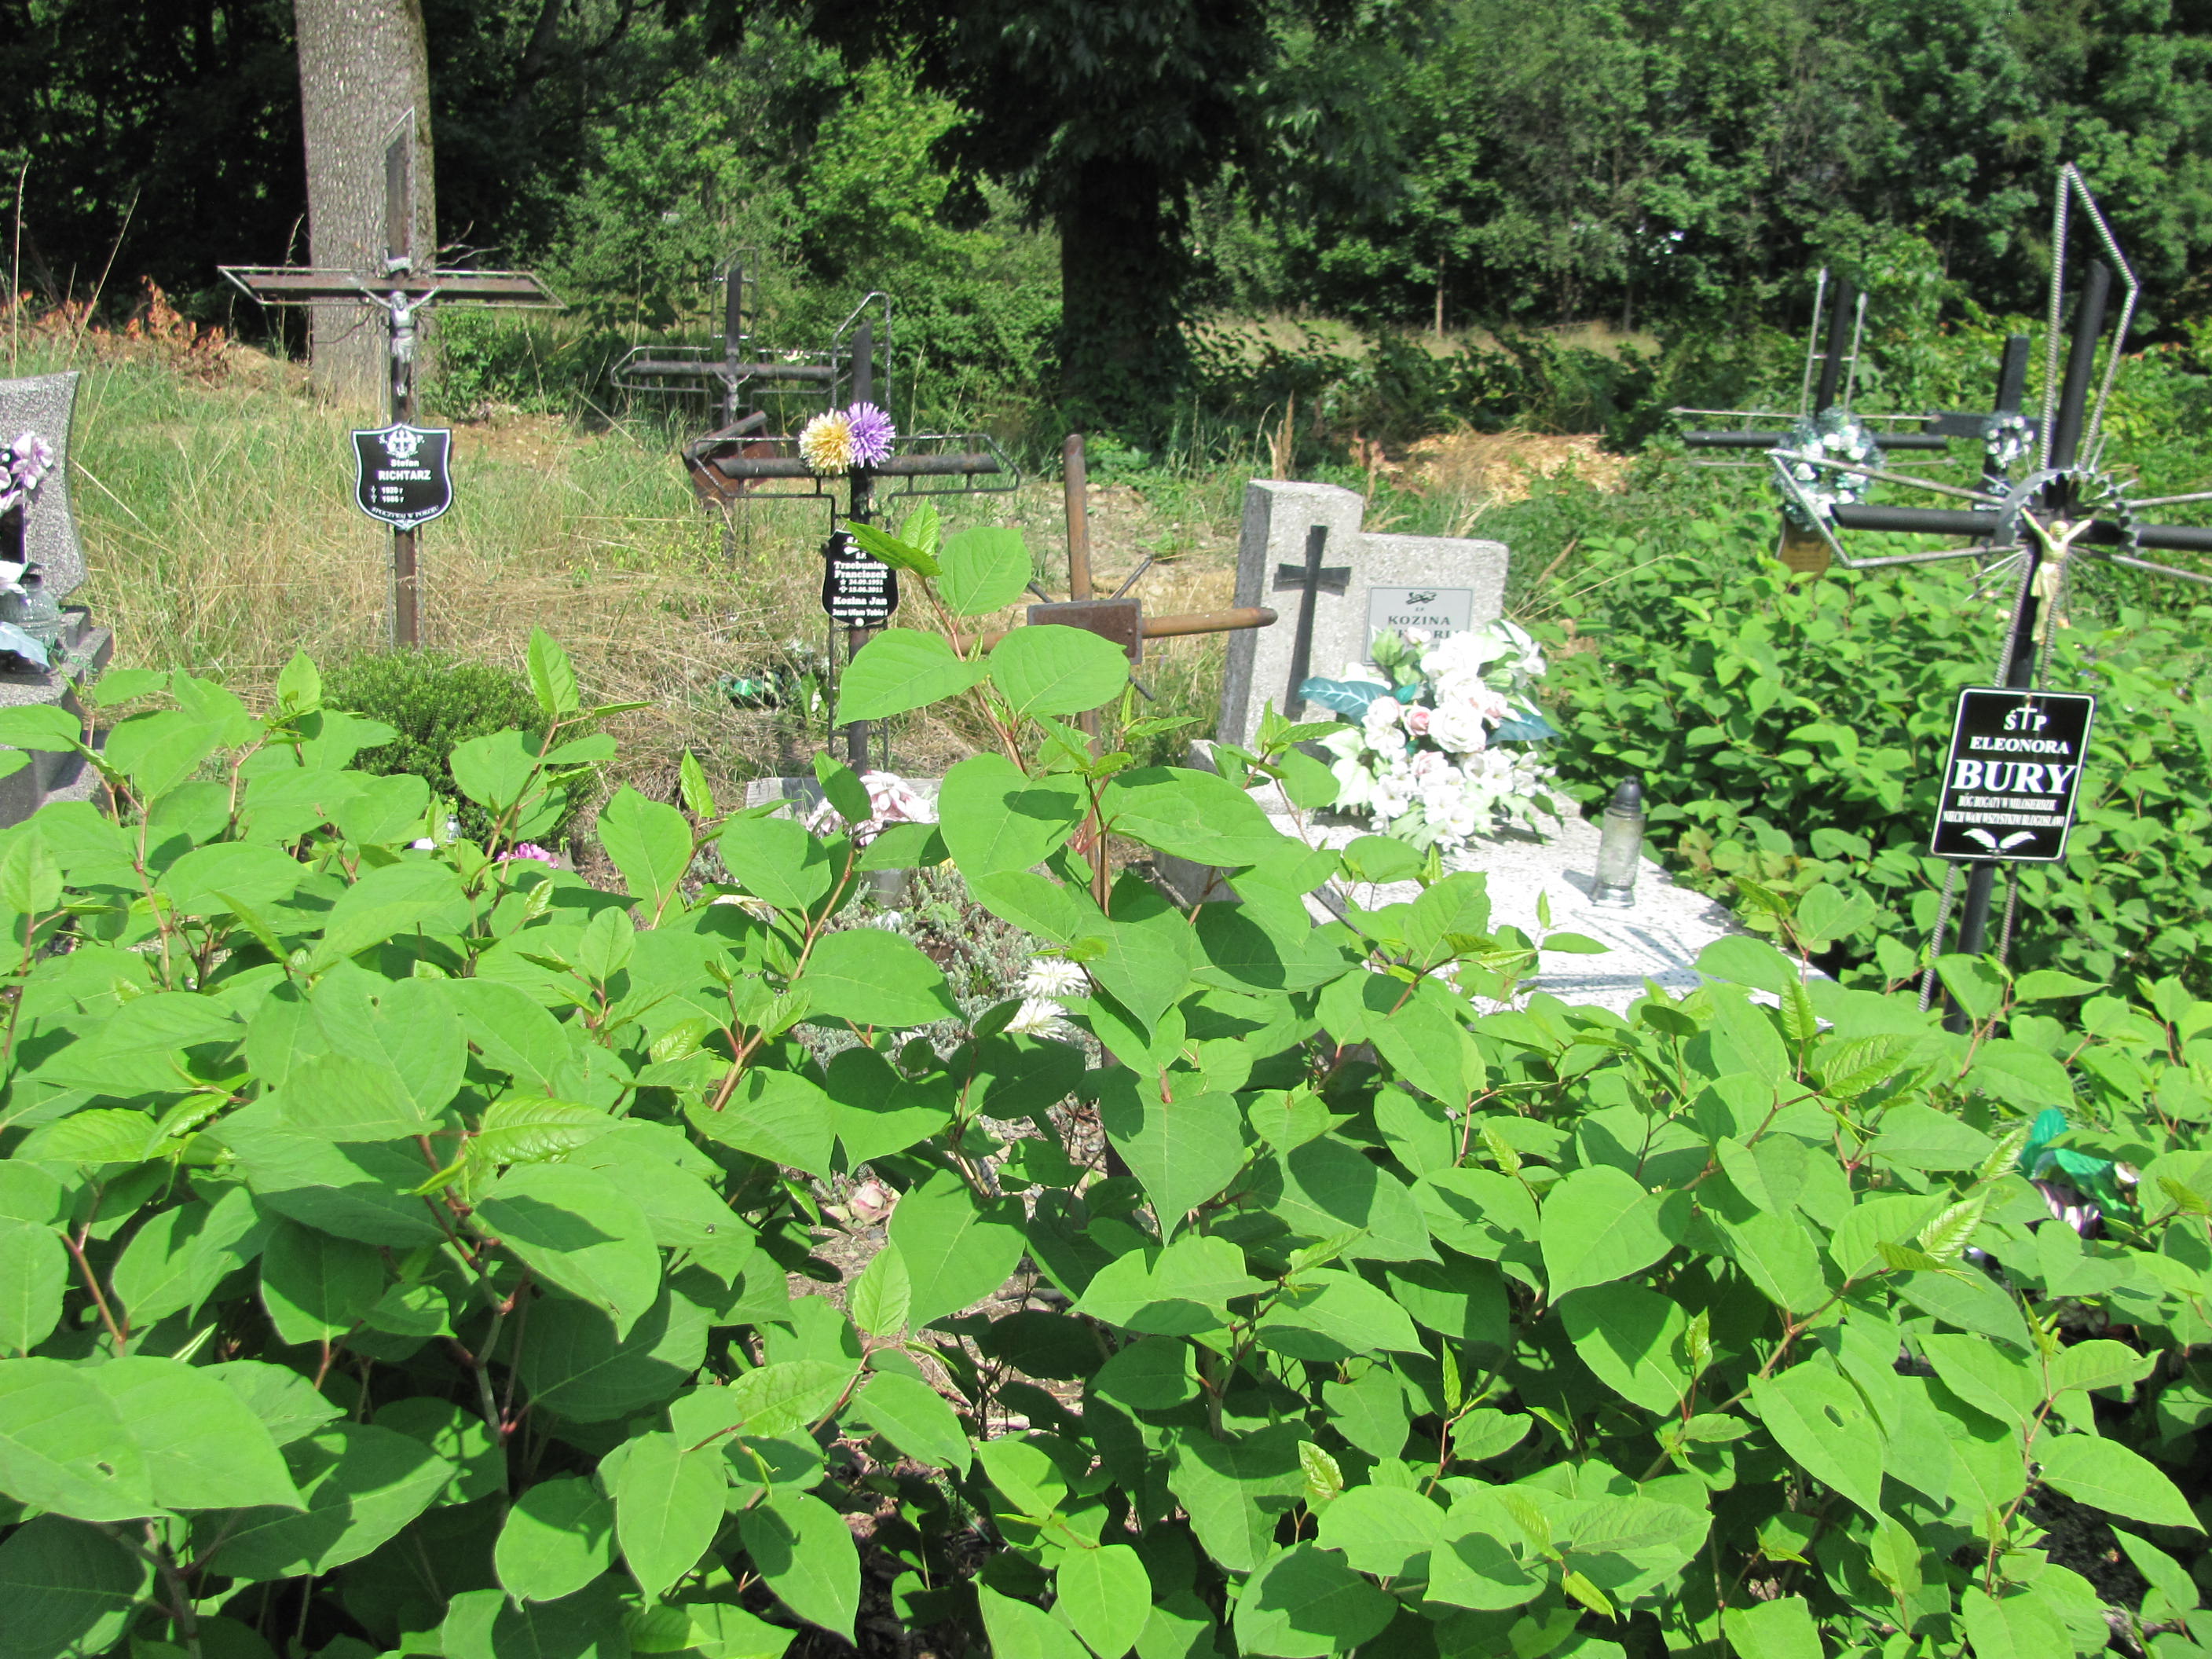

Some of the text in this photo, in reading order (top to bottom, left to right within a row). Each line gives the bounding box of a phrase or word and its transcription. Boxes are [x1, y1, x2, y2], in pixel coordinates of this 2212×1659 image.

[390, 459, 420, 467] Stefan
[377, 470, 432, 481] RICHTARZ
[833, 569, 888, 579] Franciszek
[833, 596, 888, 606] Kozina Jan
[848, 608, 866, 617] Ufam
[866, 608, 884, 617] Tobie
[1388, 615, 1451, 625] KOZINA
[1968, 736, 2069, 755] ELEONORA
[1950, 759, 2077, 794] BURY
